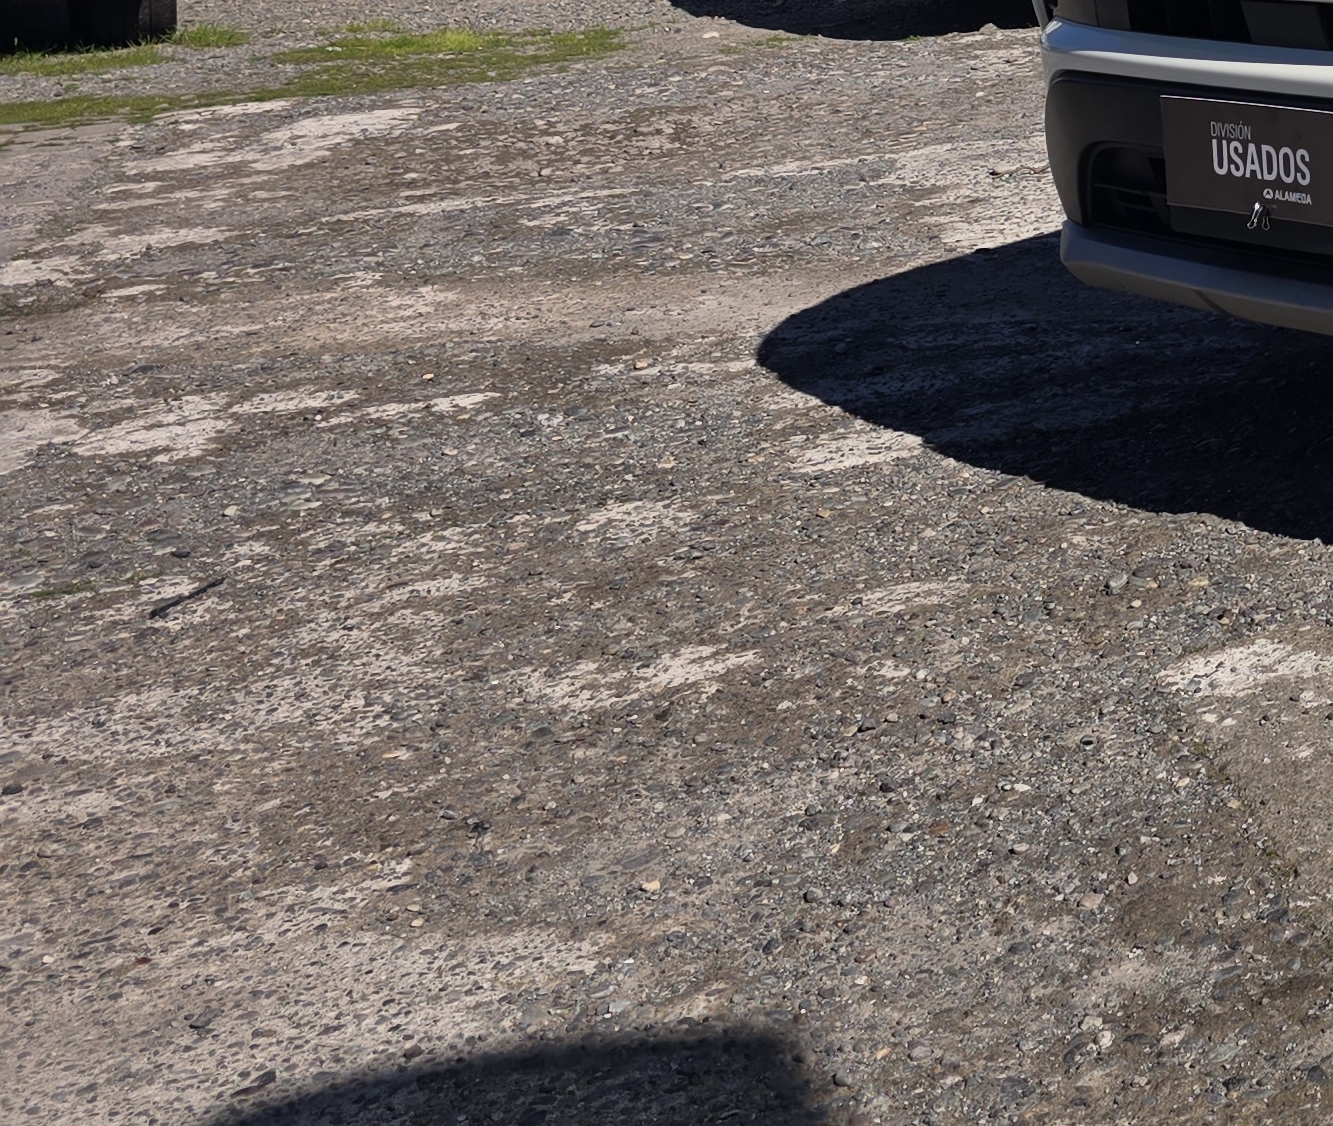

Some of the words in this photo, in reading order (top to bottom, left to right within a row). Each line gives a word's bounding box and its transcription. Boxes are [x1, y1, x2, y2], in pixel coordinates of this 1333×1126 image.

[1210, 121, 1252, 141] DIVISIÓN
[1211, 138, 1311, 186] USADOS
[1274, 189, 1313, 205] ALAMEDA
